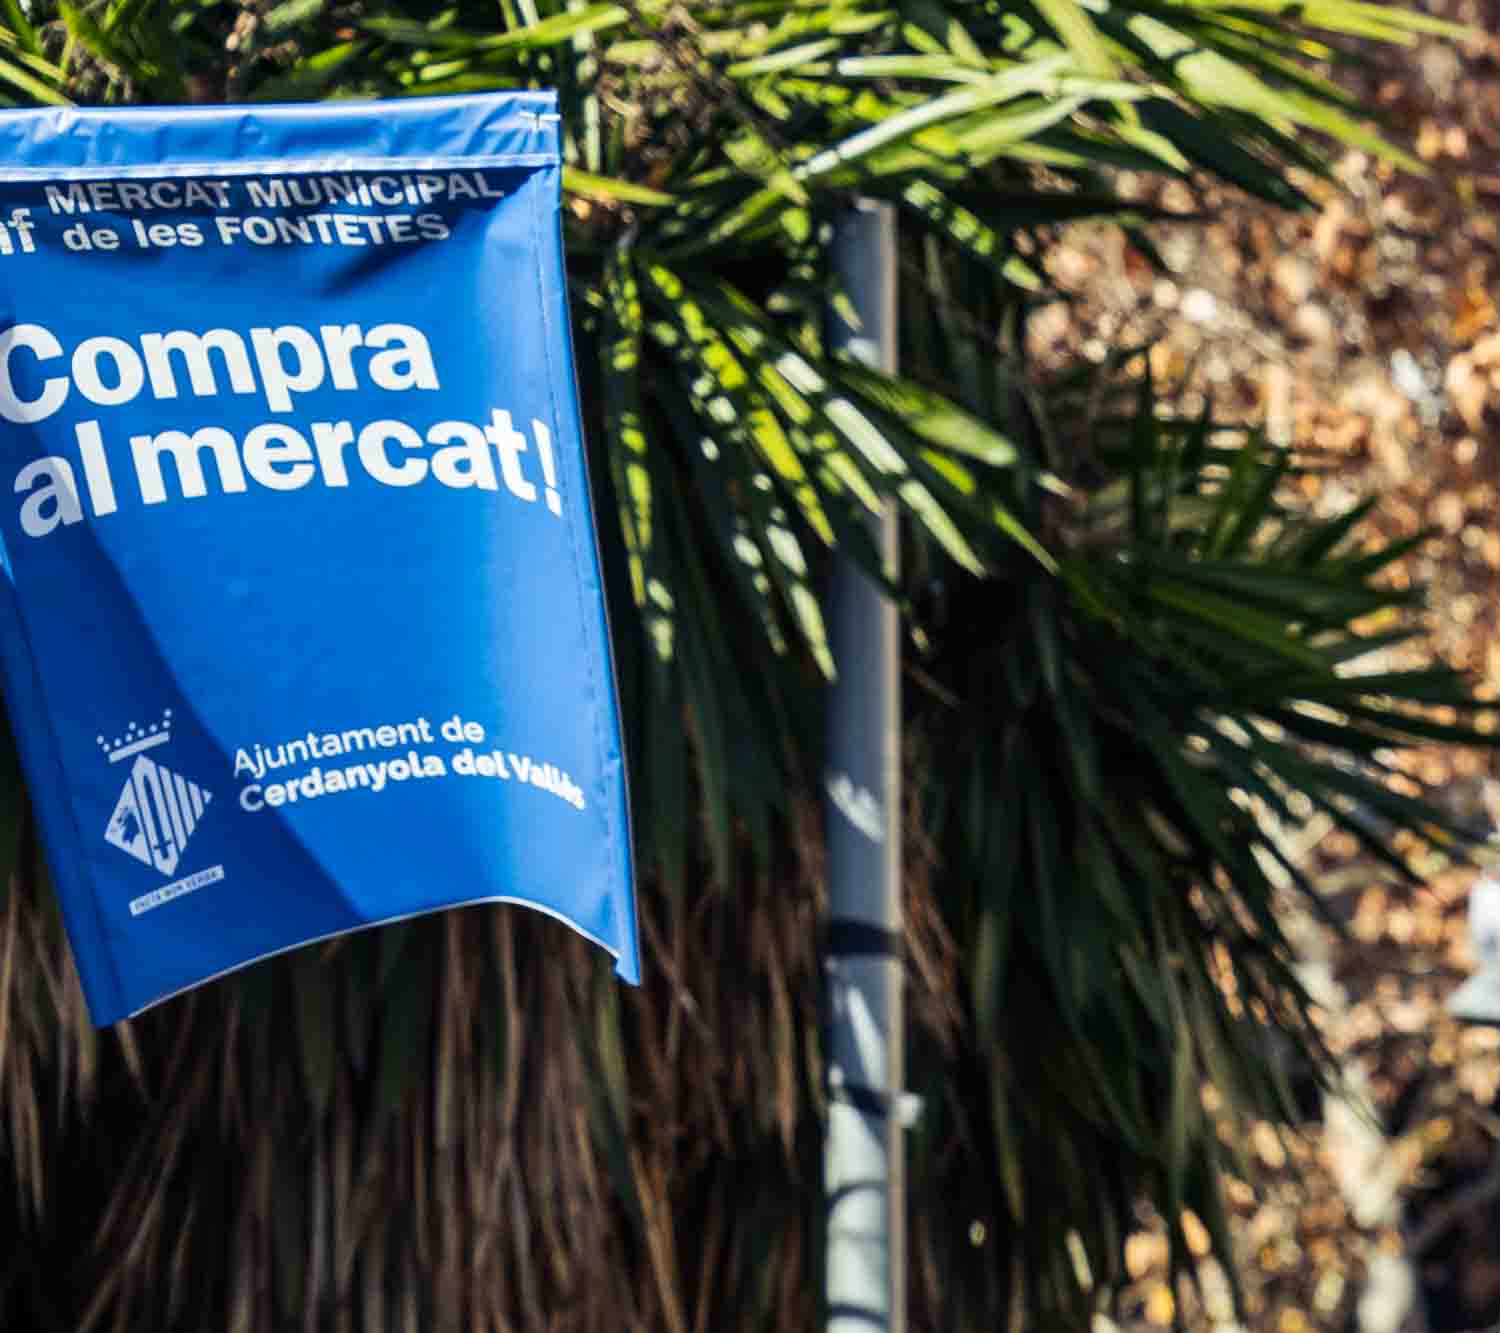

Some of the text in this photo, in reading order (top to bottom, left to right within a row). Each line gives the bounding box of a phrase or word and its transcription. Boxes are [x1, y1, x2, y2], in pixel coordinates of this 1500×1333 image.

[44, 171, 504, 214] MERCAT MUNICIPAL
[63, 213, 449, 251] de les FONTETES
[0, 322, 440, 424] Compra
[13, 408, 563, 538] al mercat!
[233, 714, 486, 779] Ajuntament de
[239, 750, 447, 812] Cerdanyola
[452, 748, 511, 780] del
